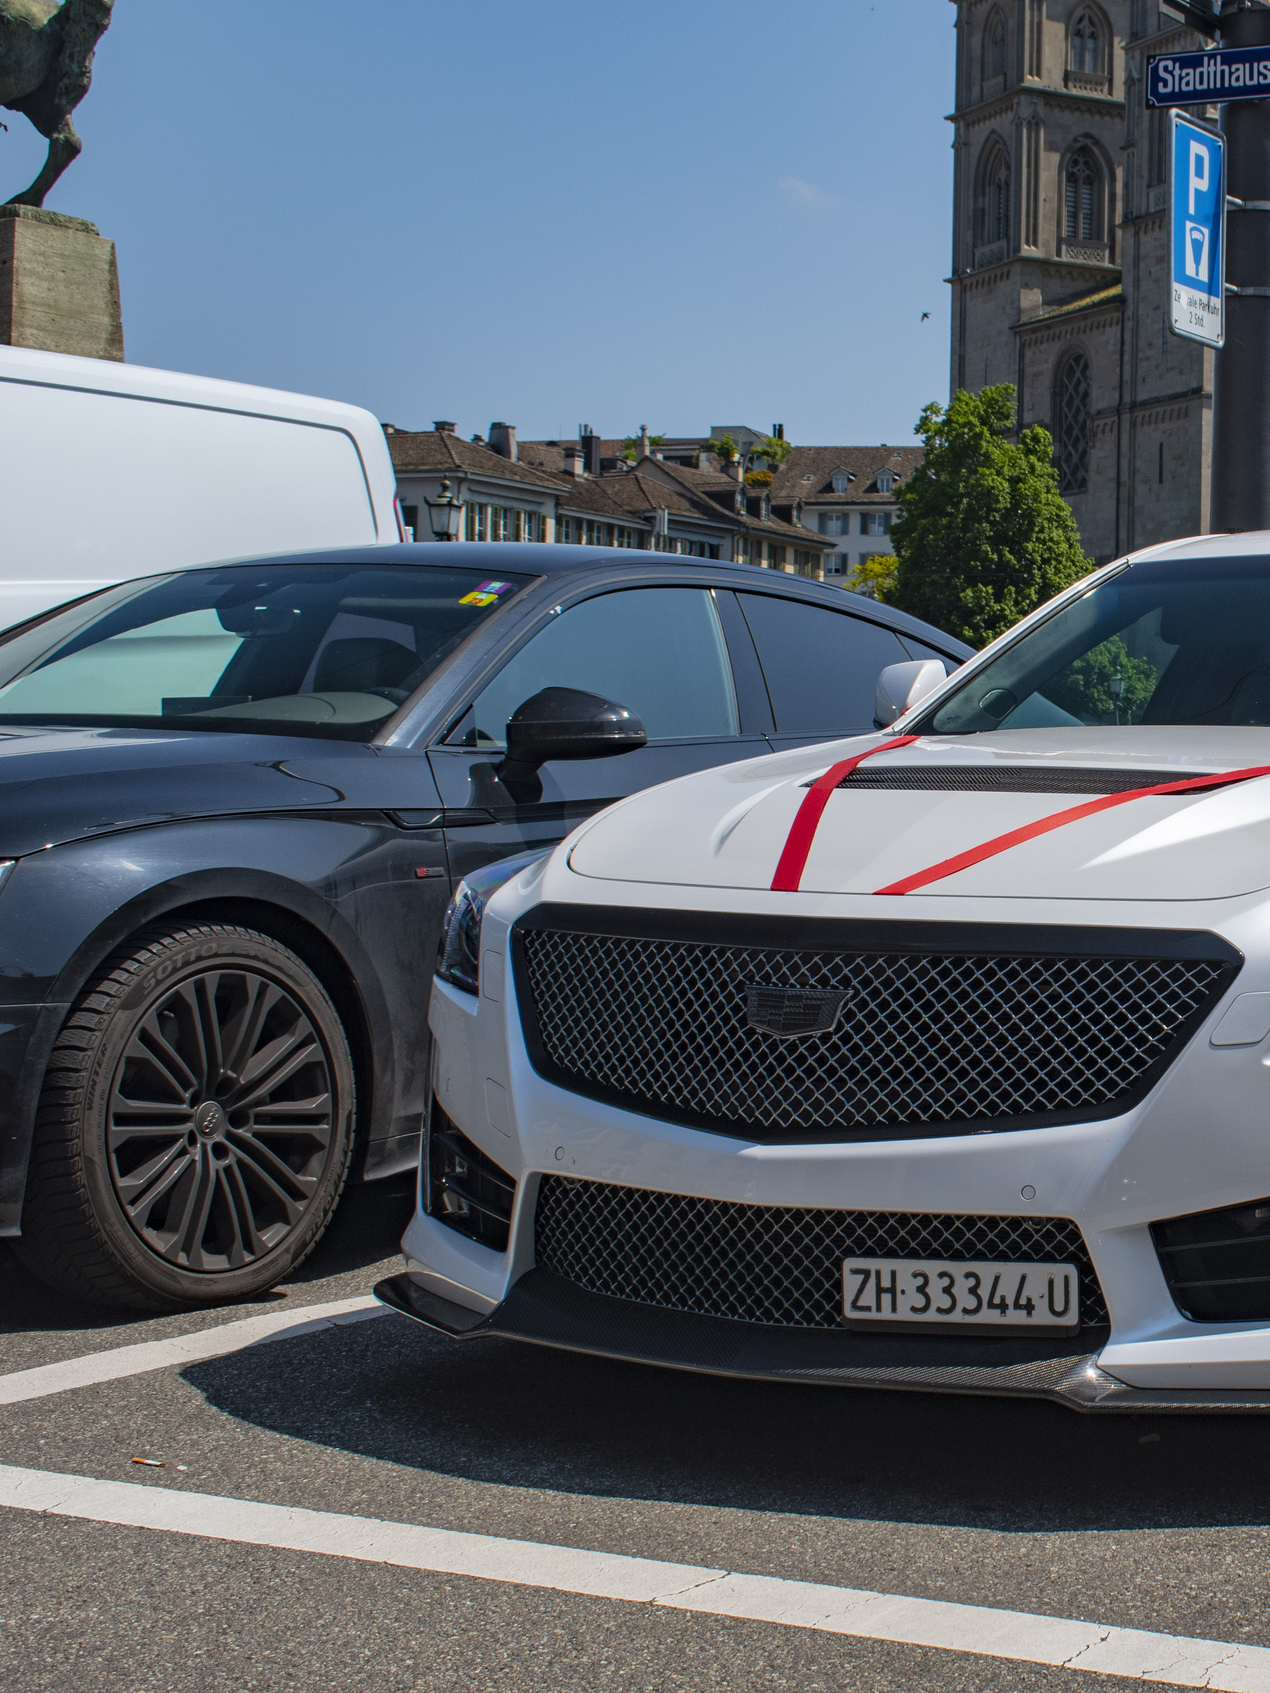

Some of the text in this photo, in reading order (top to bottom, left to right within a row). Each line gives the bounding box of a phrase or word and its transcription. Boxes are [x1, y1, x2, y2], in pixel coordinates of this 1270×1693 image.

[1188, 138, 1210, 216] P
[1173, 288, 1198, 309] Zeale
[1189, 310, 1193, 324] 2
[85, 1041, 109, 1112] WINTER
